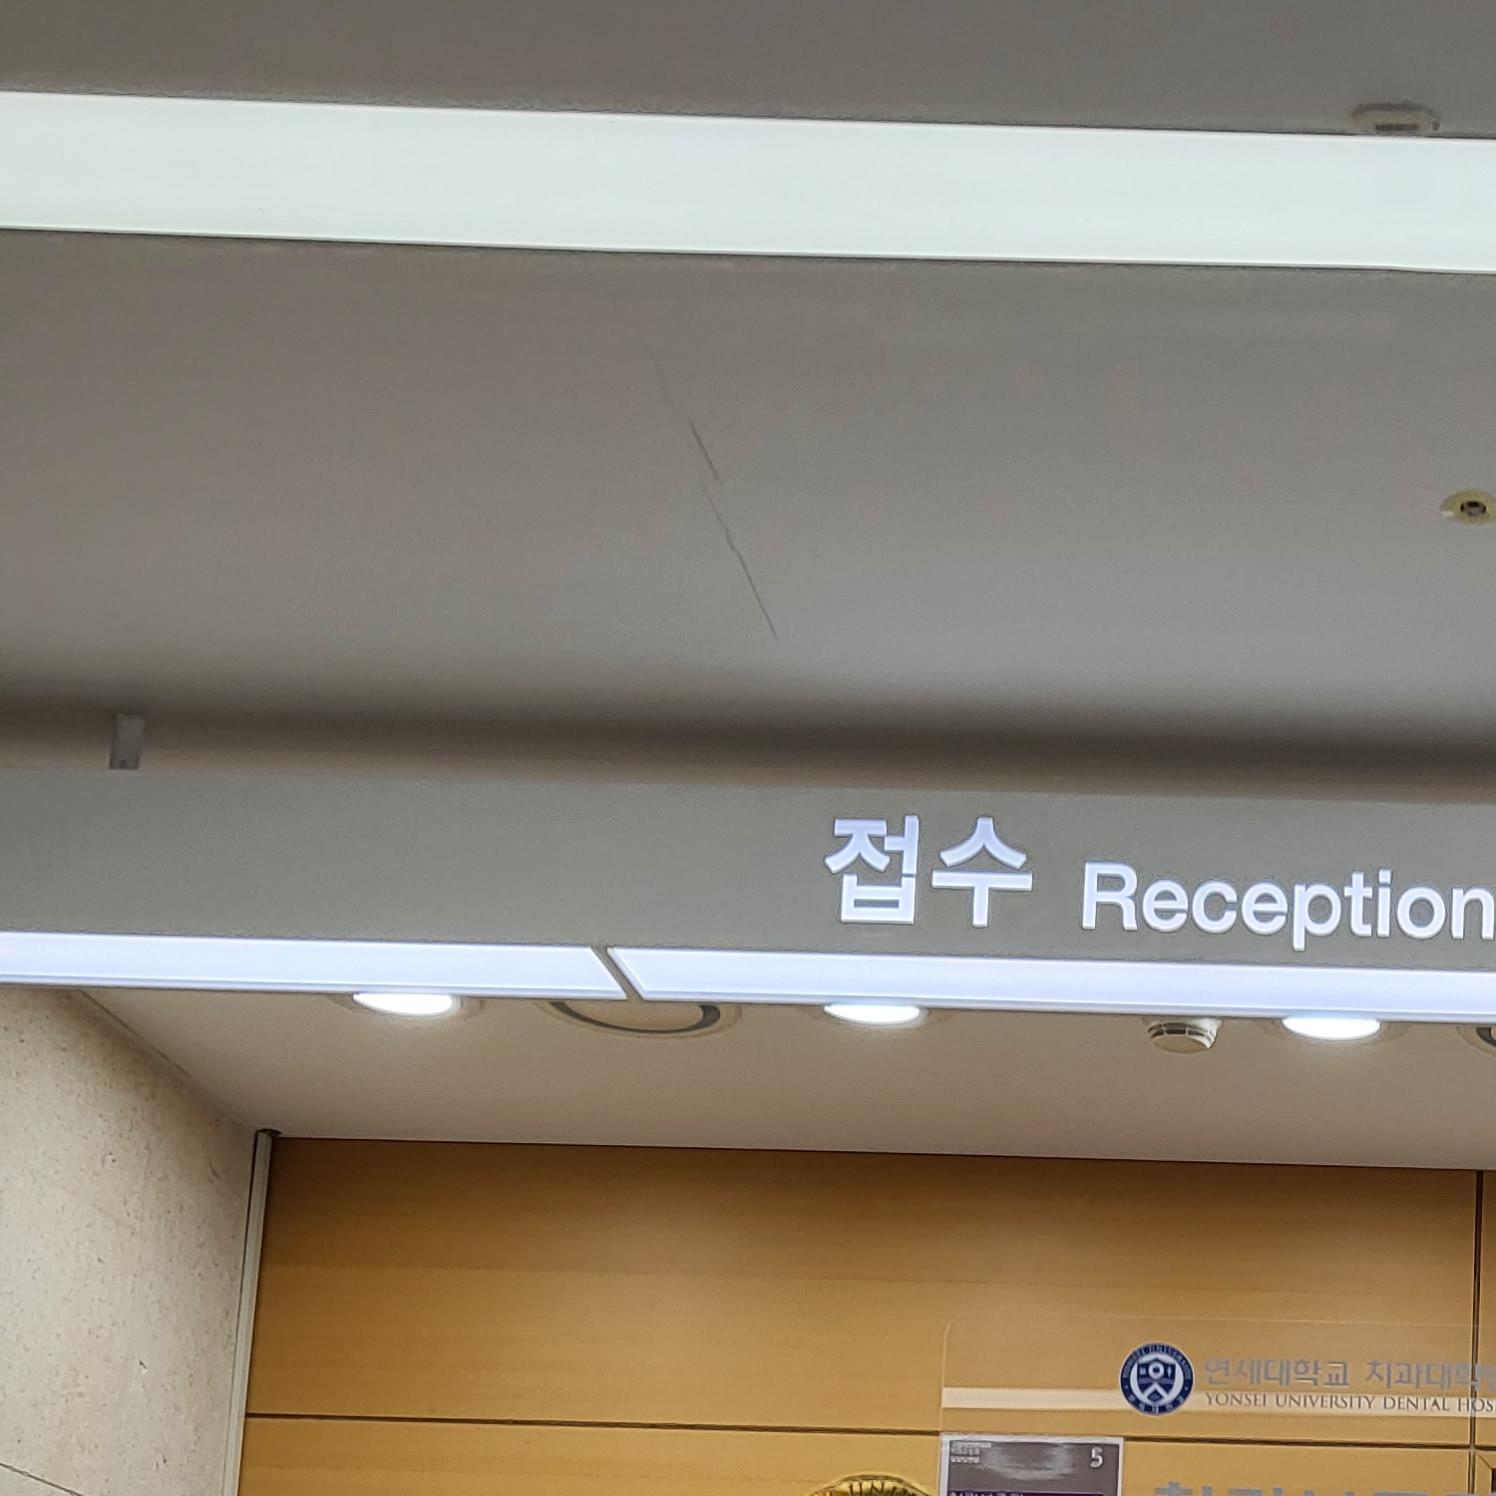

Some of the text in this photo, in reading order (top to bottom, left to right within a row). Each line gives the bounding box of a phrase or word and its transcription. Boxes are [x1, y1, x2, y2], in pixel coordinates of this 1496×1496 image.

[825, 815, 1496, 952] 접수 Reception
[1205, 1358, 1350, 1388] 연세대학교
[1205, 1392, 1267, 1408] YONSEI
[1275, 1393, 1376, 1410] UNIVERSITY
[1383, 1395, 1450, 1412] DENTAL
[1090, 1447, 1103, 1468] 5
